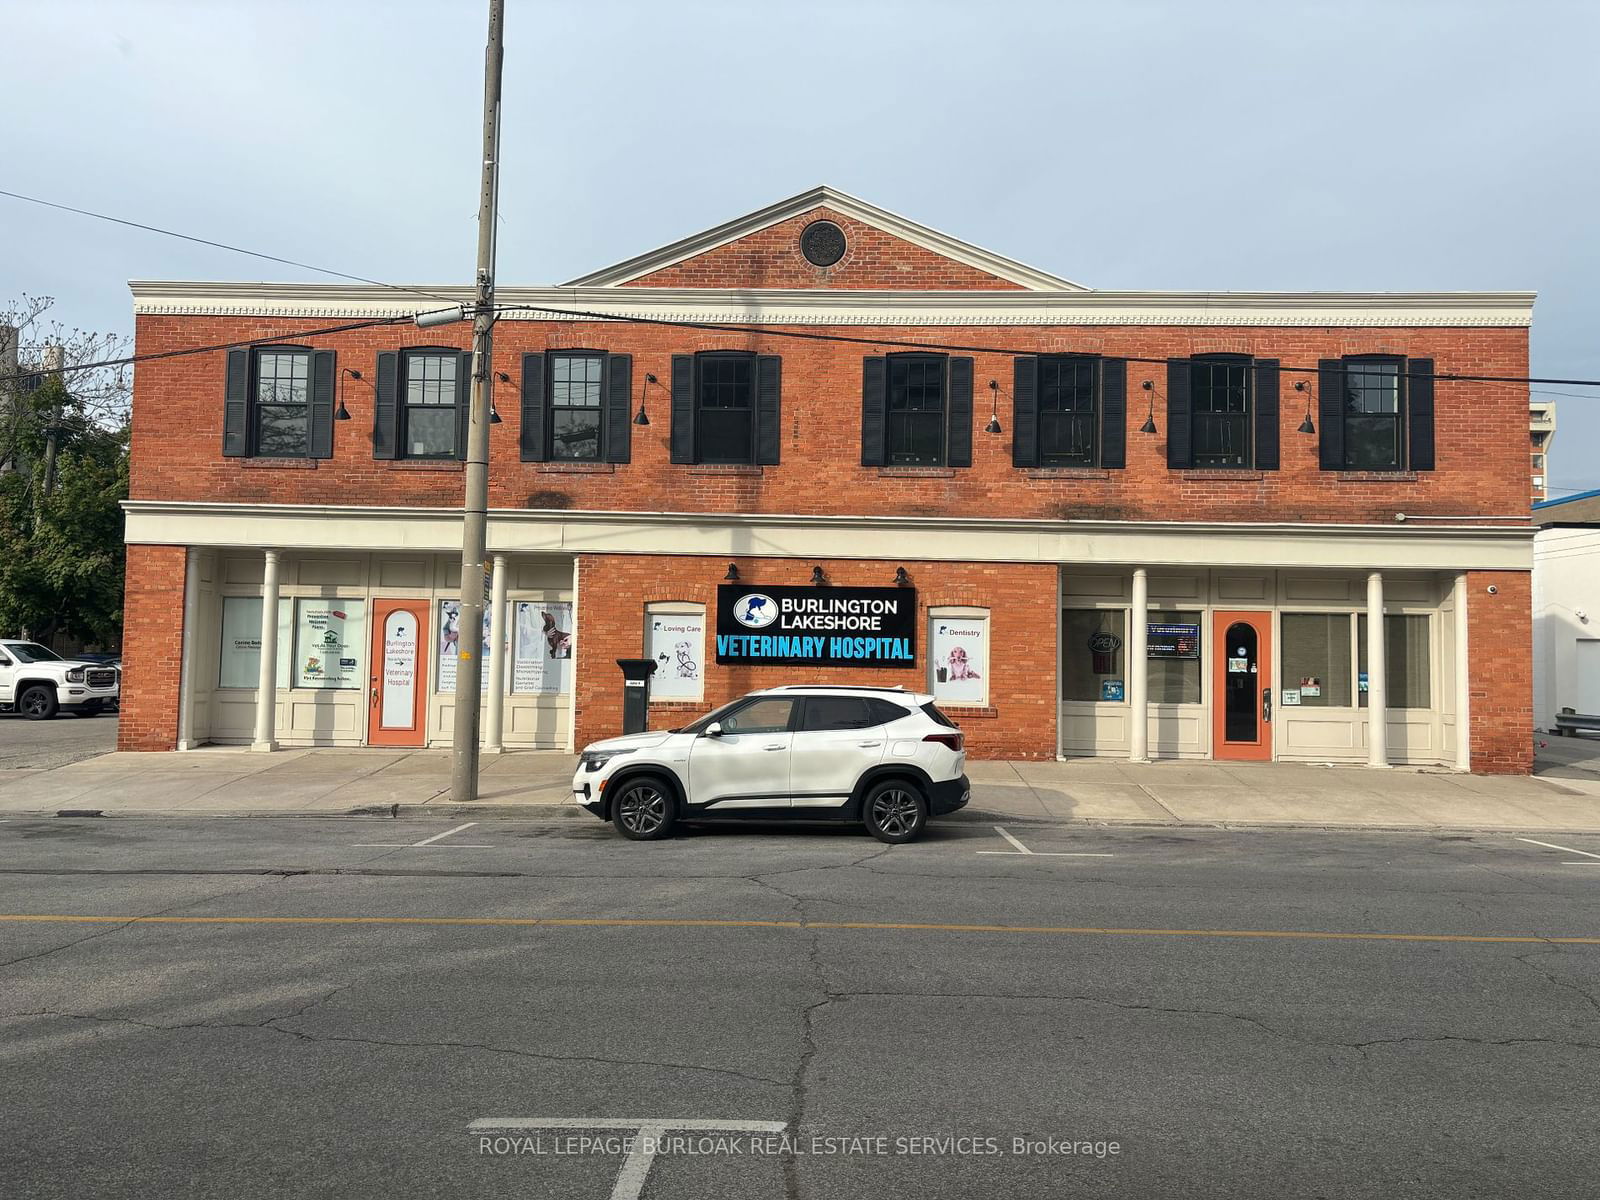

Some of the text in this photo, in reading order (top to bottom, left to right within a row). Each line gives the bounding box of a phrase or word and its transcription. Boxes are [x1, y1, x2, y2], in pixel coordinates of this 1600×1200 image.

[781, 598, 898, 614] BURLINGTON
[781, 615, 882, 631] LAKESHORE
[663, 625, 702, 633] Loving Care
[949, 629, 981, 638] Dentistry
[386, 640, 415, 648] Burlington
[717, 635, 914, 660] VETERINARY HOSPITAL
[386, 668, 413, 677] Veterinary
